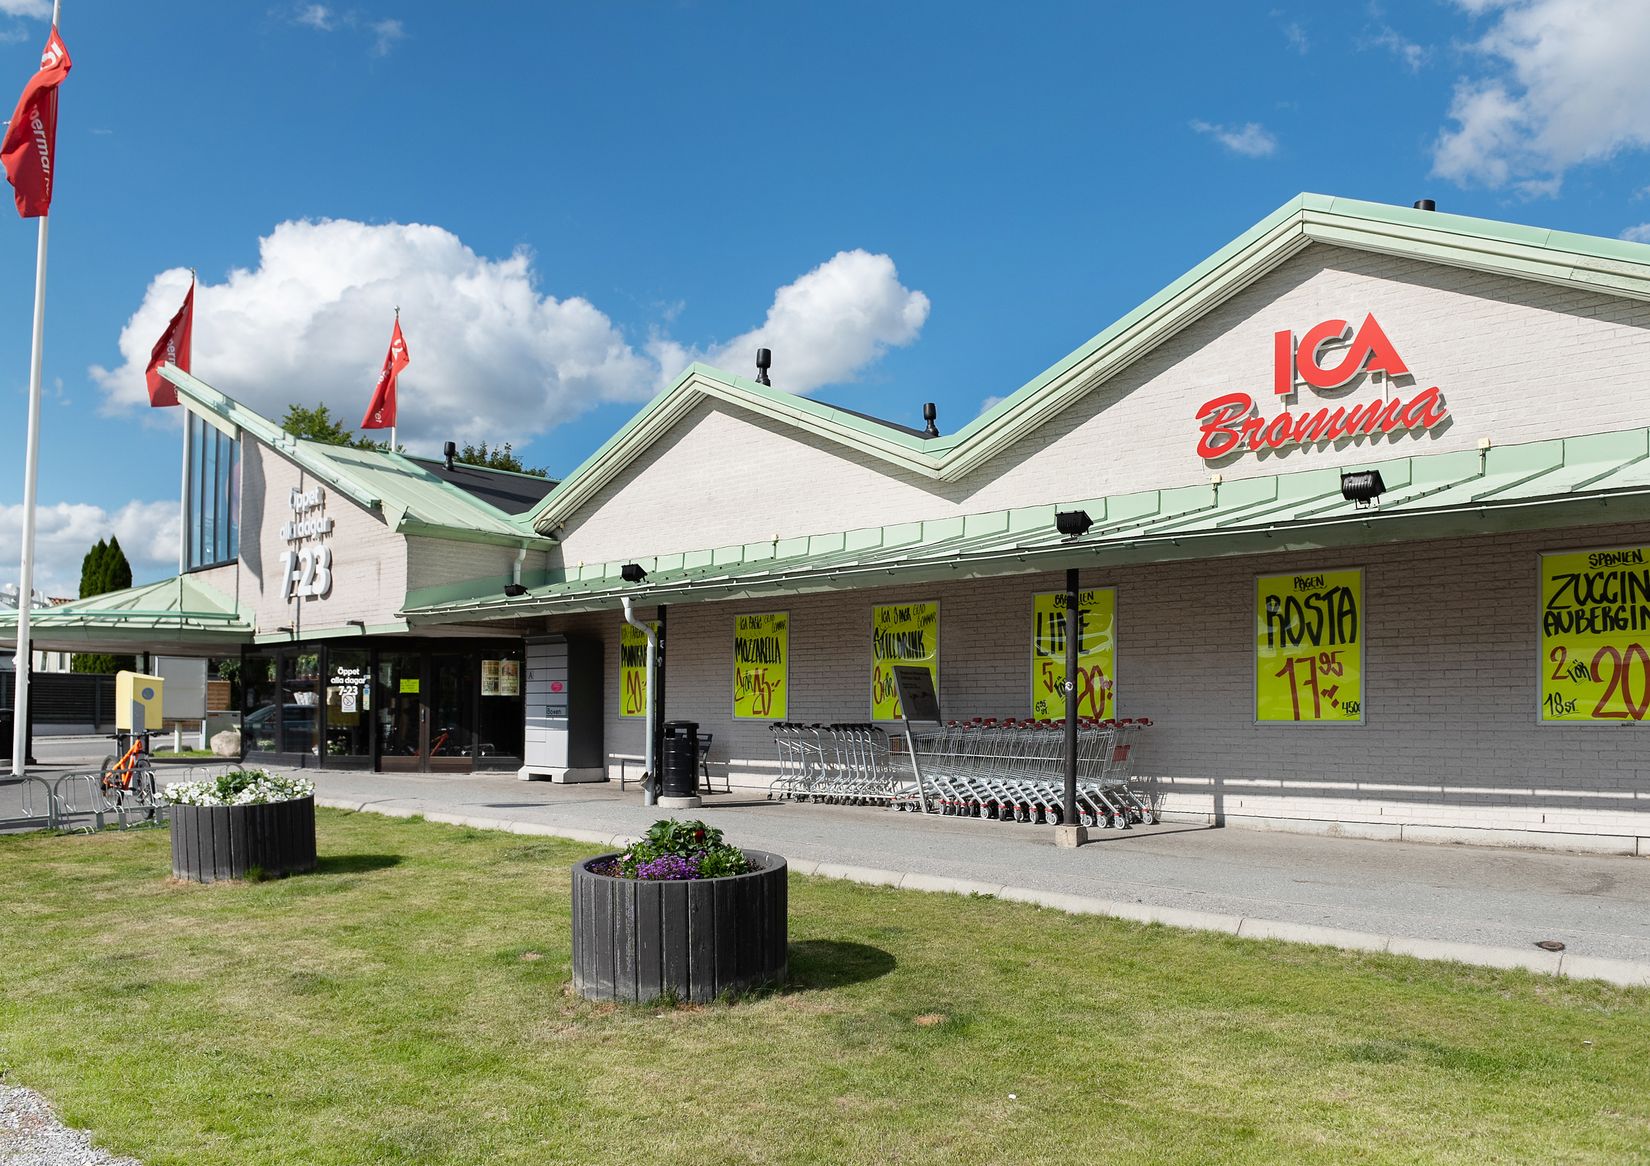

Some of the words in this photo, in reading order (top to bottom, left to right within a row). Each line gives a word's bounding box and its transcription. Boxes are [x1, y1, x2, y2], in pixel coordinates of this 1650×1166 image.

[1274, 312, 1410, 395] ICA
[1195, 386, 1447, 459] Bromma
[279, 545, 331, 599] 7-23
[1588, 549, 1644, 568] SPANIEN
[1546, 569, 1650, 609] ZUCCIN
[1265, 585, 1357, 649] ROSTA
[1543, 604, 1650, 637] AUBERGIN
[330, 676, 344, 684] alla
[344, 677, 366, 686] dagar
[337, 666, 360, 676] Öppet
[1042, 662, 1053, 693] 5
[1550, 646, 1569, 680] 2
[338, 686, 358, 695] 7-23
[873, 666, 883, 704] 3
[1275, 656, 1321, 721] 17
[1318, 651, 1345, 677] 95
